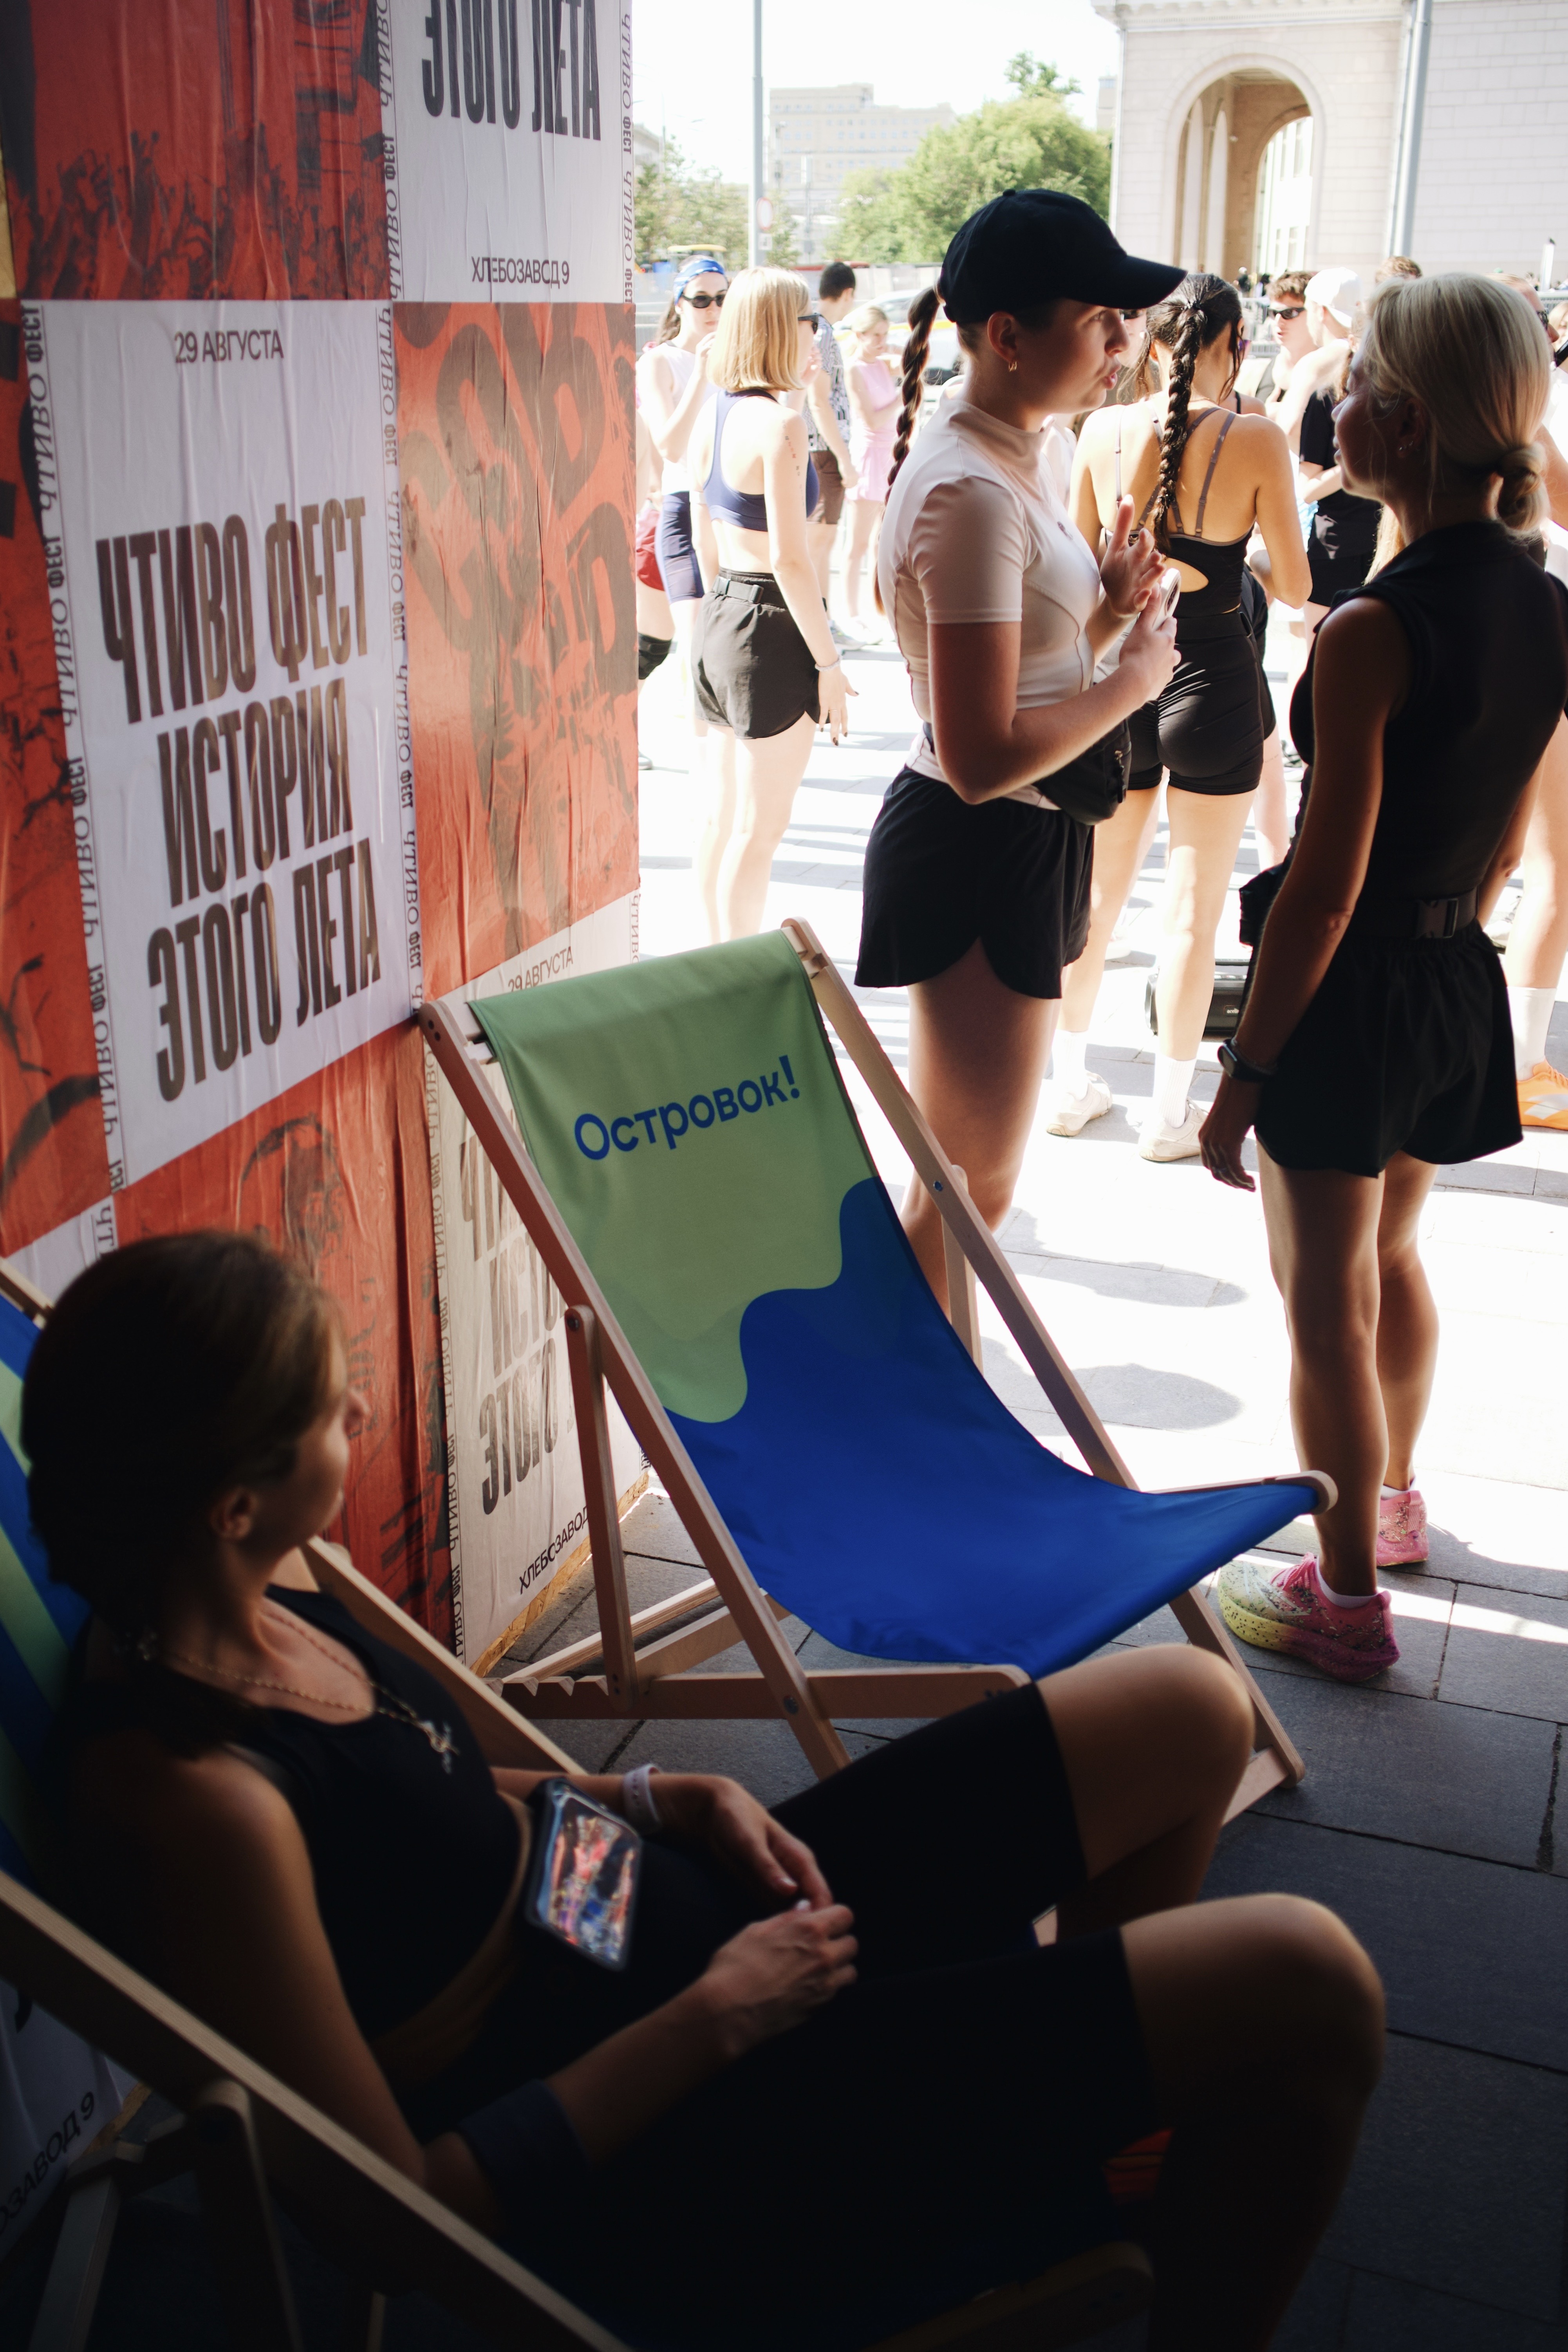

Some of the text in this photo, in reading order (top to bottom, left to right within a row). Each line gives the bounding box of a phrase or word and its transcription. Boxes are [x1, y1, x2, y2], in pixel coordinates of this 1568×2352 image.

[622, 14, 631, 109] ЧТИВО
[383, 134, 396, 180] ФЕСТ
[623, 116, 631, 154] ФЕСТ
[386, 189, 402, 299] ЧТИВО
[623, 171, 632, 261] ЧТИВО
[471, 256, 569, 289] ХЛЕБОЗАВОД 9
[21, 307, 43, 363] ФЕСТ
[174, 329, 284, 363] 29 АВГУСТА
[378, 307, 394, 416] ЧТИВО
[28, 374, 57, 511] ЧТИВО
[383, 424, 397, 466] ФЕСТ
[43, 535, 65, 588] ФЕСТ
[388, 490, 403, 596] ЧТИВО
[96, 497, 367, 724] ЧТИВО ФЕСТ
[392, 601, 406, 641] ФЕСТ
[50, 598, 77, 727] ЧТИВО
[396, 665, 411, 763] ЧТИВО
[157, 677, 353, 908] ИСТОРИЯ
[400, 770, 414, 809] ФЕСТ
[74, 816, 99, 938] ЧТИВО
[403, 830, 419, 925] ЧТИВО
[147, 838, 381, 1102] ЭТОГО ЛЕТА
[409, 932, 421, 969] ФЕСТ
[525, 946, 573, 990] АВГУСТА
[94, 1021, 118, 1136] ЧТИВО
[574, 1055, 800, 1160] Островок!
[109, 1160, 124, 1193] ЕСТ
[480, 1338, 558, 1515] ЭТОГО
[81, 2092, 95, 2120] 9
